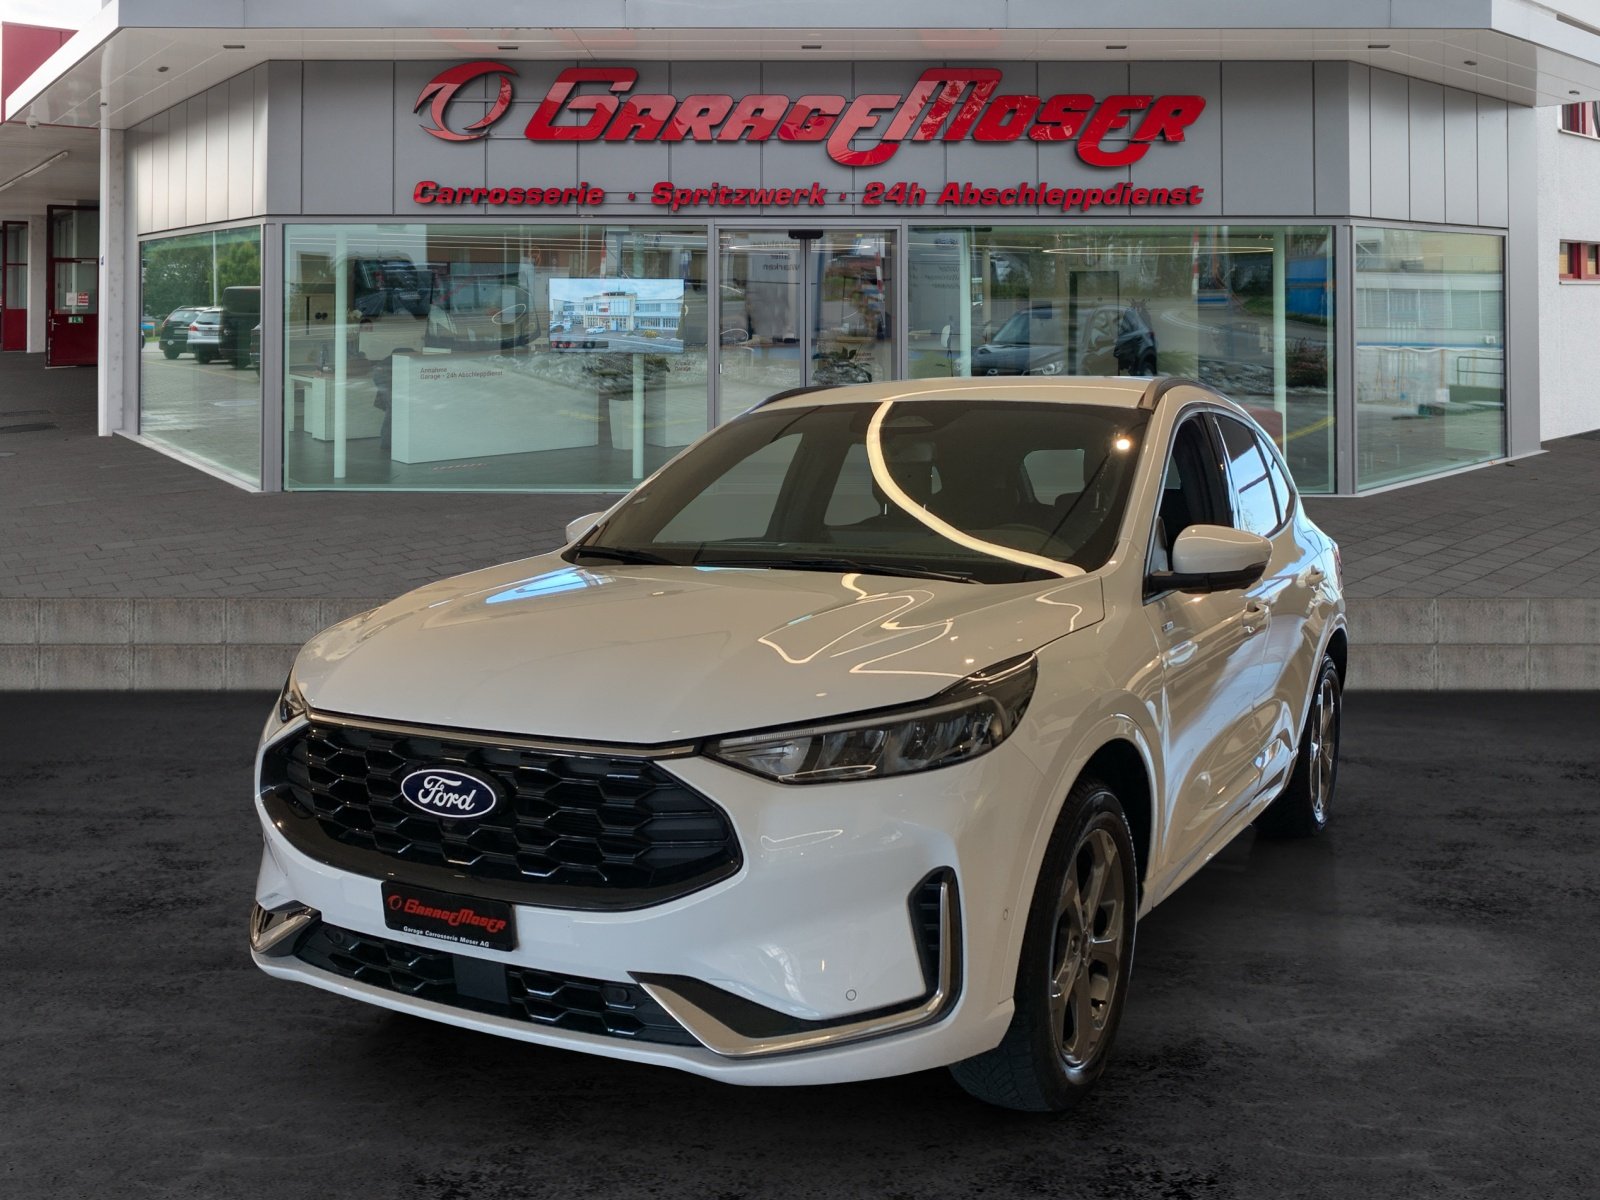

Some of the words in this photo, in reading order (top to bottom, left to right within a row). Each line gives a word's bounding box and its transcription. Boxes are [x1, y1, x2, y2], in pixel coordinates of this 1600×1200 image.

[413, 181, 605, 206] Carrosserie
[651, 181, 826, 211] Spritzwerk
[862, 182, 927, 206] 24h
[937, 182, 1204, 211] Abschleppdienst
[418, 775, 477, 811] Ford
[403, 925, 424, 935] Garage
[425, 930, 458, 942] Carrosserie
[459, 936, 479, 946] Moser
[480, 940, 490, 948] AG
